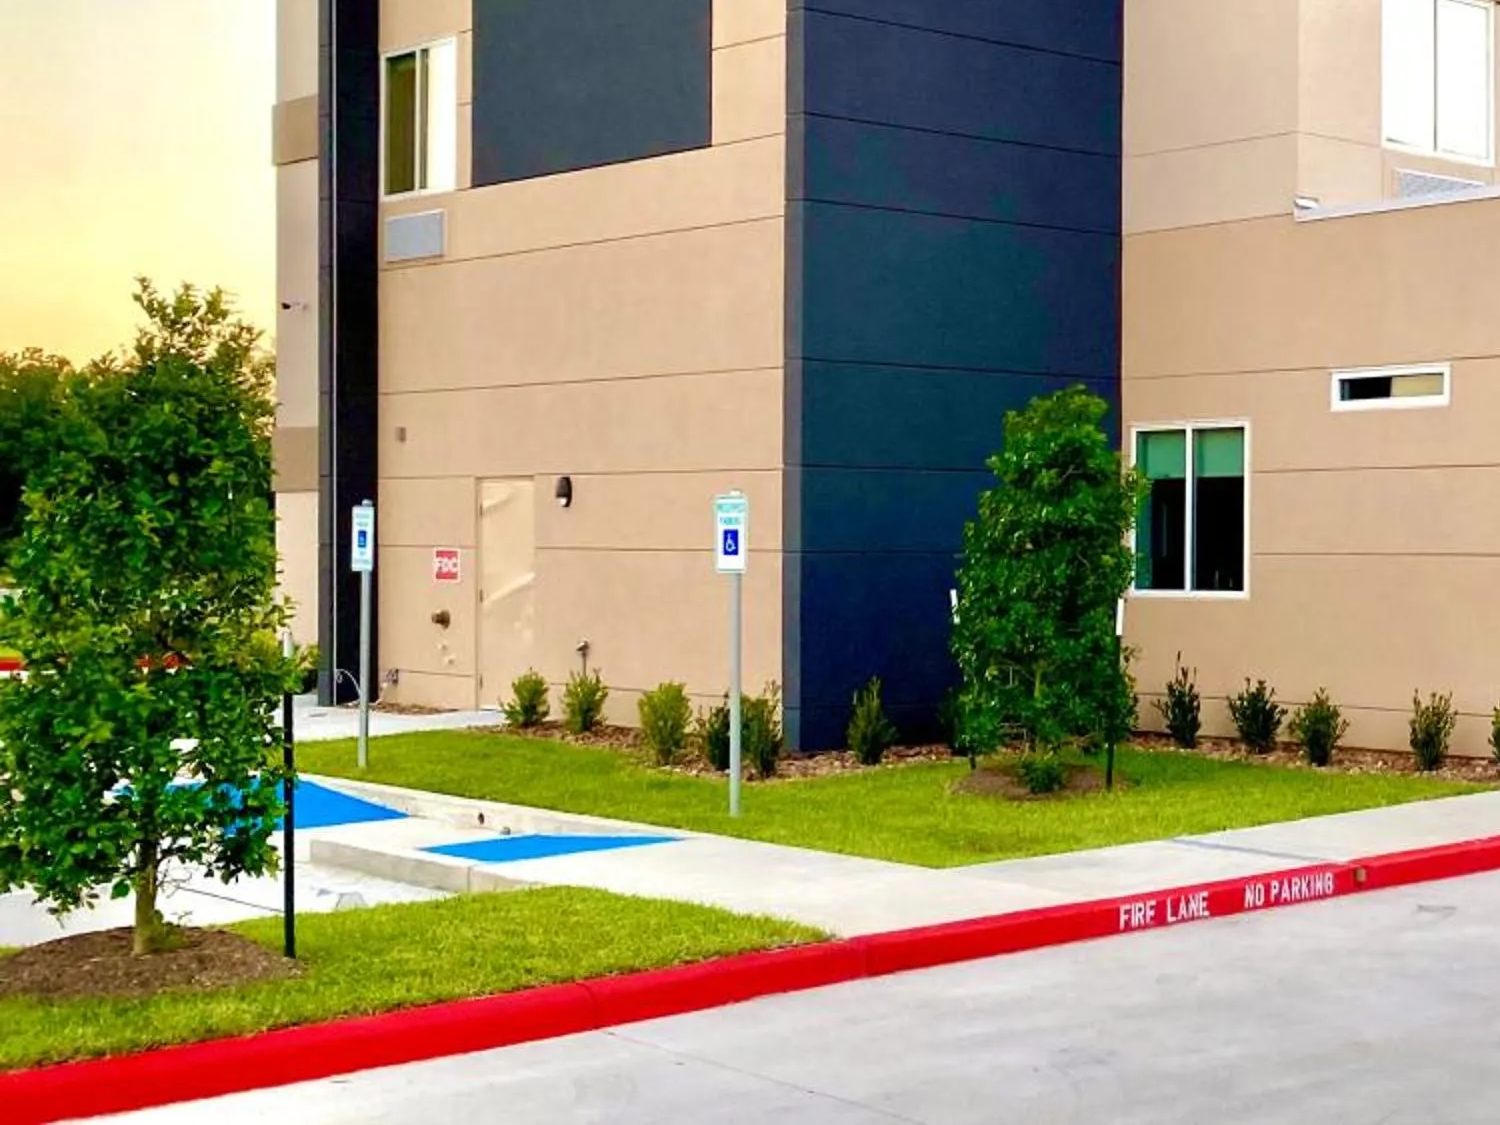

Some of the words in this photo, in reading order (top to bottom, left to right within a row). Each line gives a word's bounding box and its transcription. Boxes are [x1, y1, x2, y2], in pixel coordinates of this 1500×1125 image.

[1166, 891, 1210, 922] LANE
[1244, 884, 1265, 908] NO
[1270, 872, 1334, 906] PARKING
